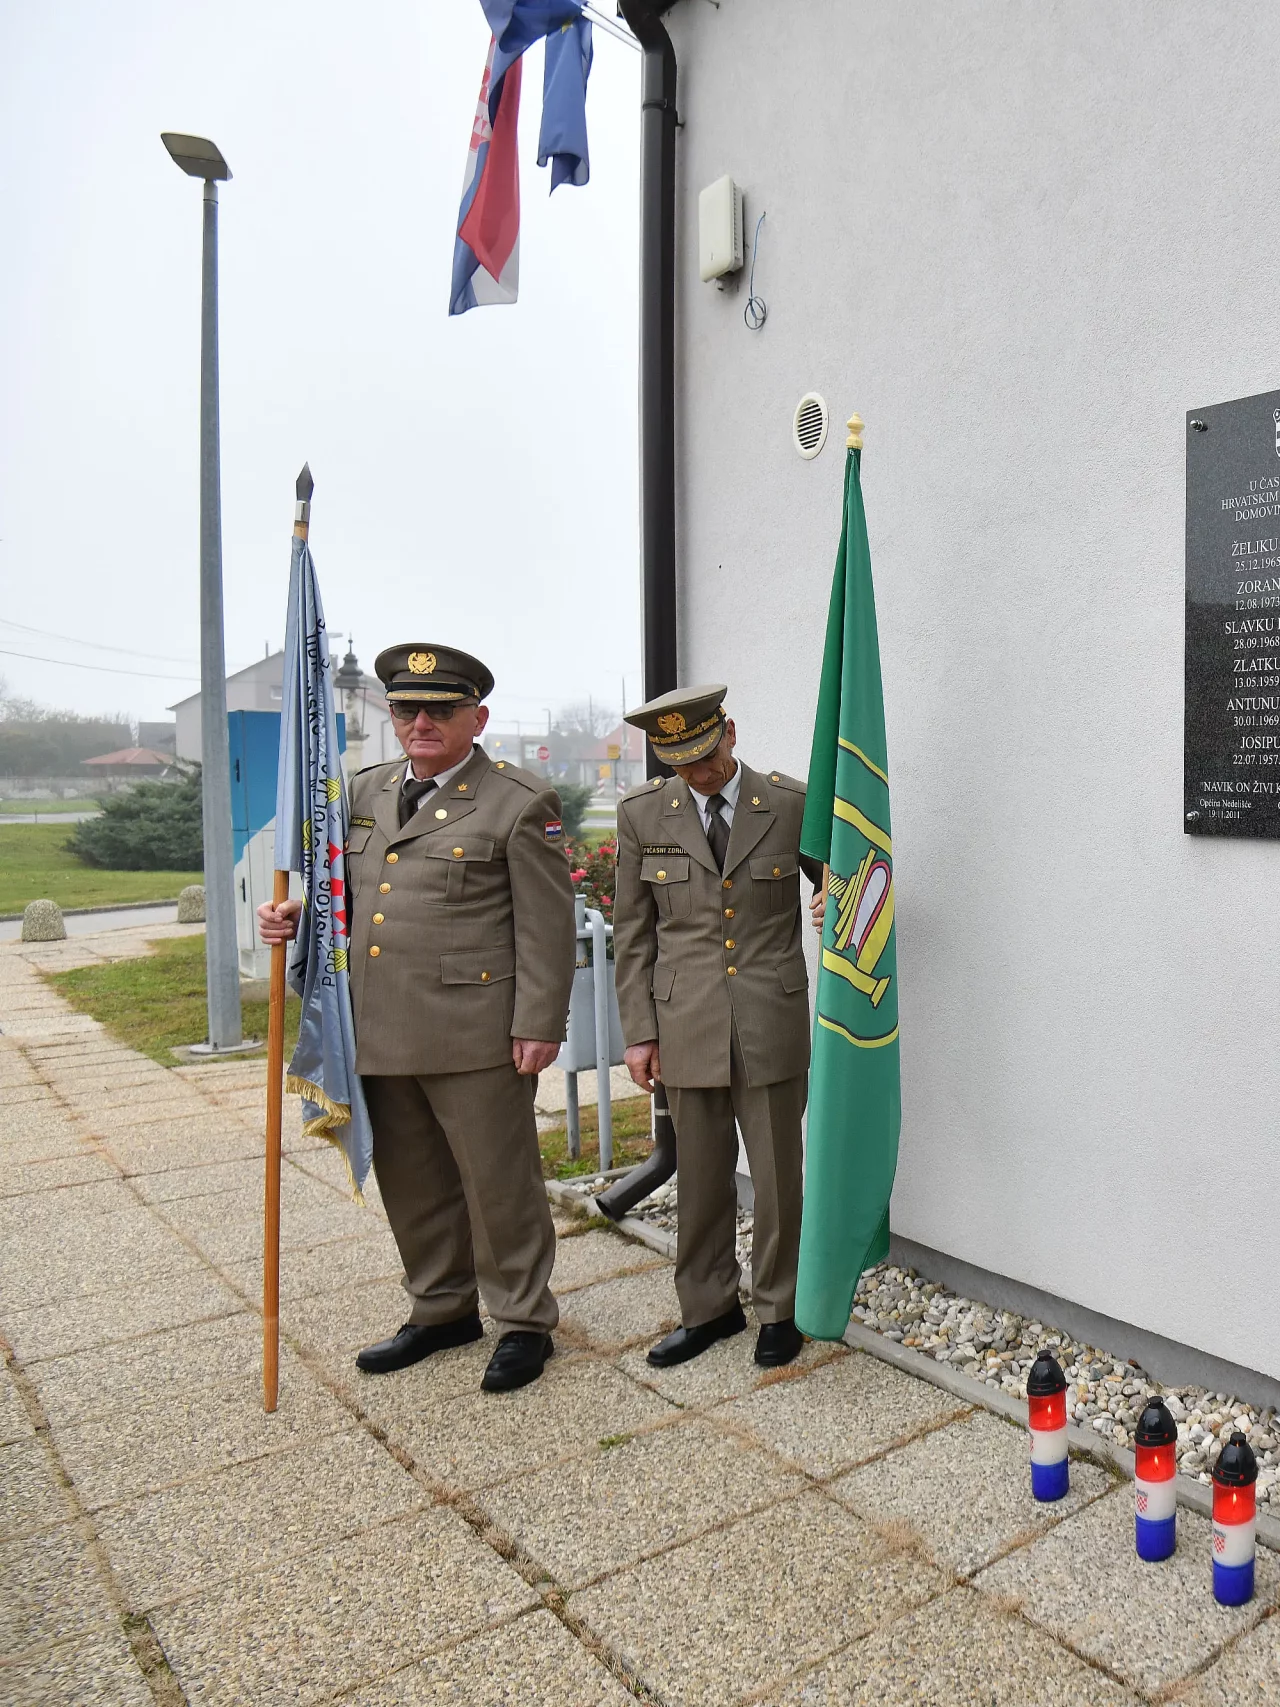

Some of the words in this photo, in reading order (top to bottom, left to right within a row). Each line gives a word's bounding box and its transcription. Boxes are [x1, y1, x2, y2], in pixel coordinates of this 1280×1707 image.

[1250, 480, 1256, 492] U
[1221, 490, 1278, 510] HRVATSKIM
[1231, 537, 1278, 557] ŽELJKU
[1224, 617, 1274, 635] SLAVKU
[1226, 696, 1280, 711] ANTUNU
[1232, 754, 1280, 766] 22.07.1957.
[1236, 782, 1250, 792] ON
[1252, 780, 1274, 794] ŽIVI
